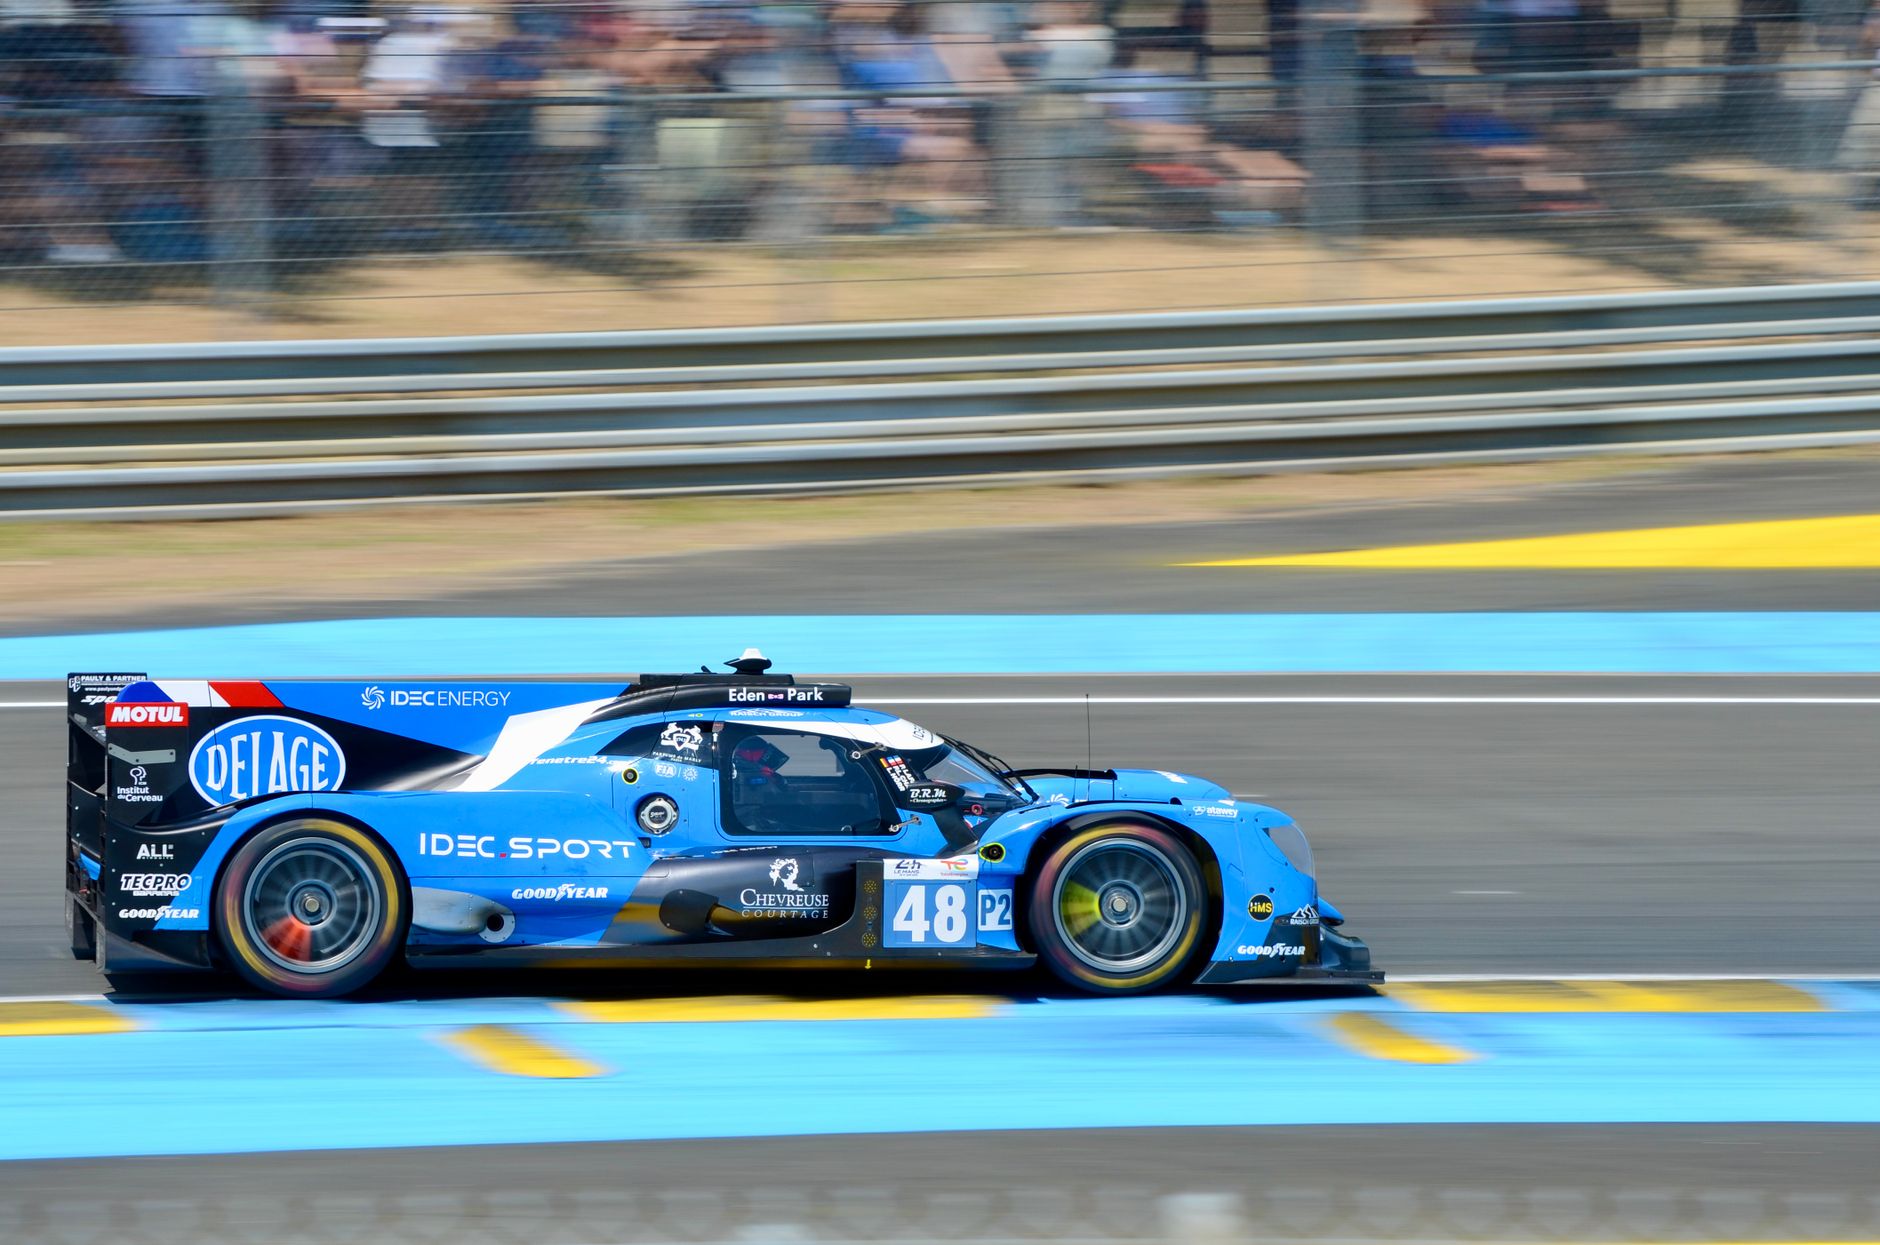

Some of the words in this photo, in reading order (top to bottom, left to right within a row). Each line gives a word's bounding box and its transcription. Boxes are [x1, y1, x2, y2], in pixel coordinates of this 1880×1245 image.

[390, 691, 435, 706] IDEC
[437, 691, 511, 706] ENERGY
[728, 688, 765, 701] Eden
[787, 687, 823, 701] Park
[110, 706, 184, 723] MOTUL
[205, 730, 329, 799] DELAGE
[656, 764, 674, 776] FIA
[117, 786, 150, 794] Institut
[125, 794, 163, 802] Cerveau
[120, 873, 192, 891] TECPRO
[511, 883, 609, 901] GOODYEAR
[740, 888, 829, 907] CHEVREUSE
[118, 905, 200, 921] GOODYEAR
[741, 909, 829, 919] COURTAGE
[892, 884, 967, 943] 48
[980, 894, 1011, 926] P2
[1237, 942, 1306, 958] GOODYEAR
